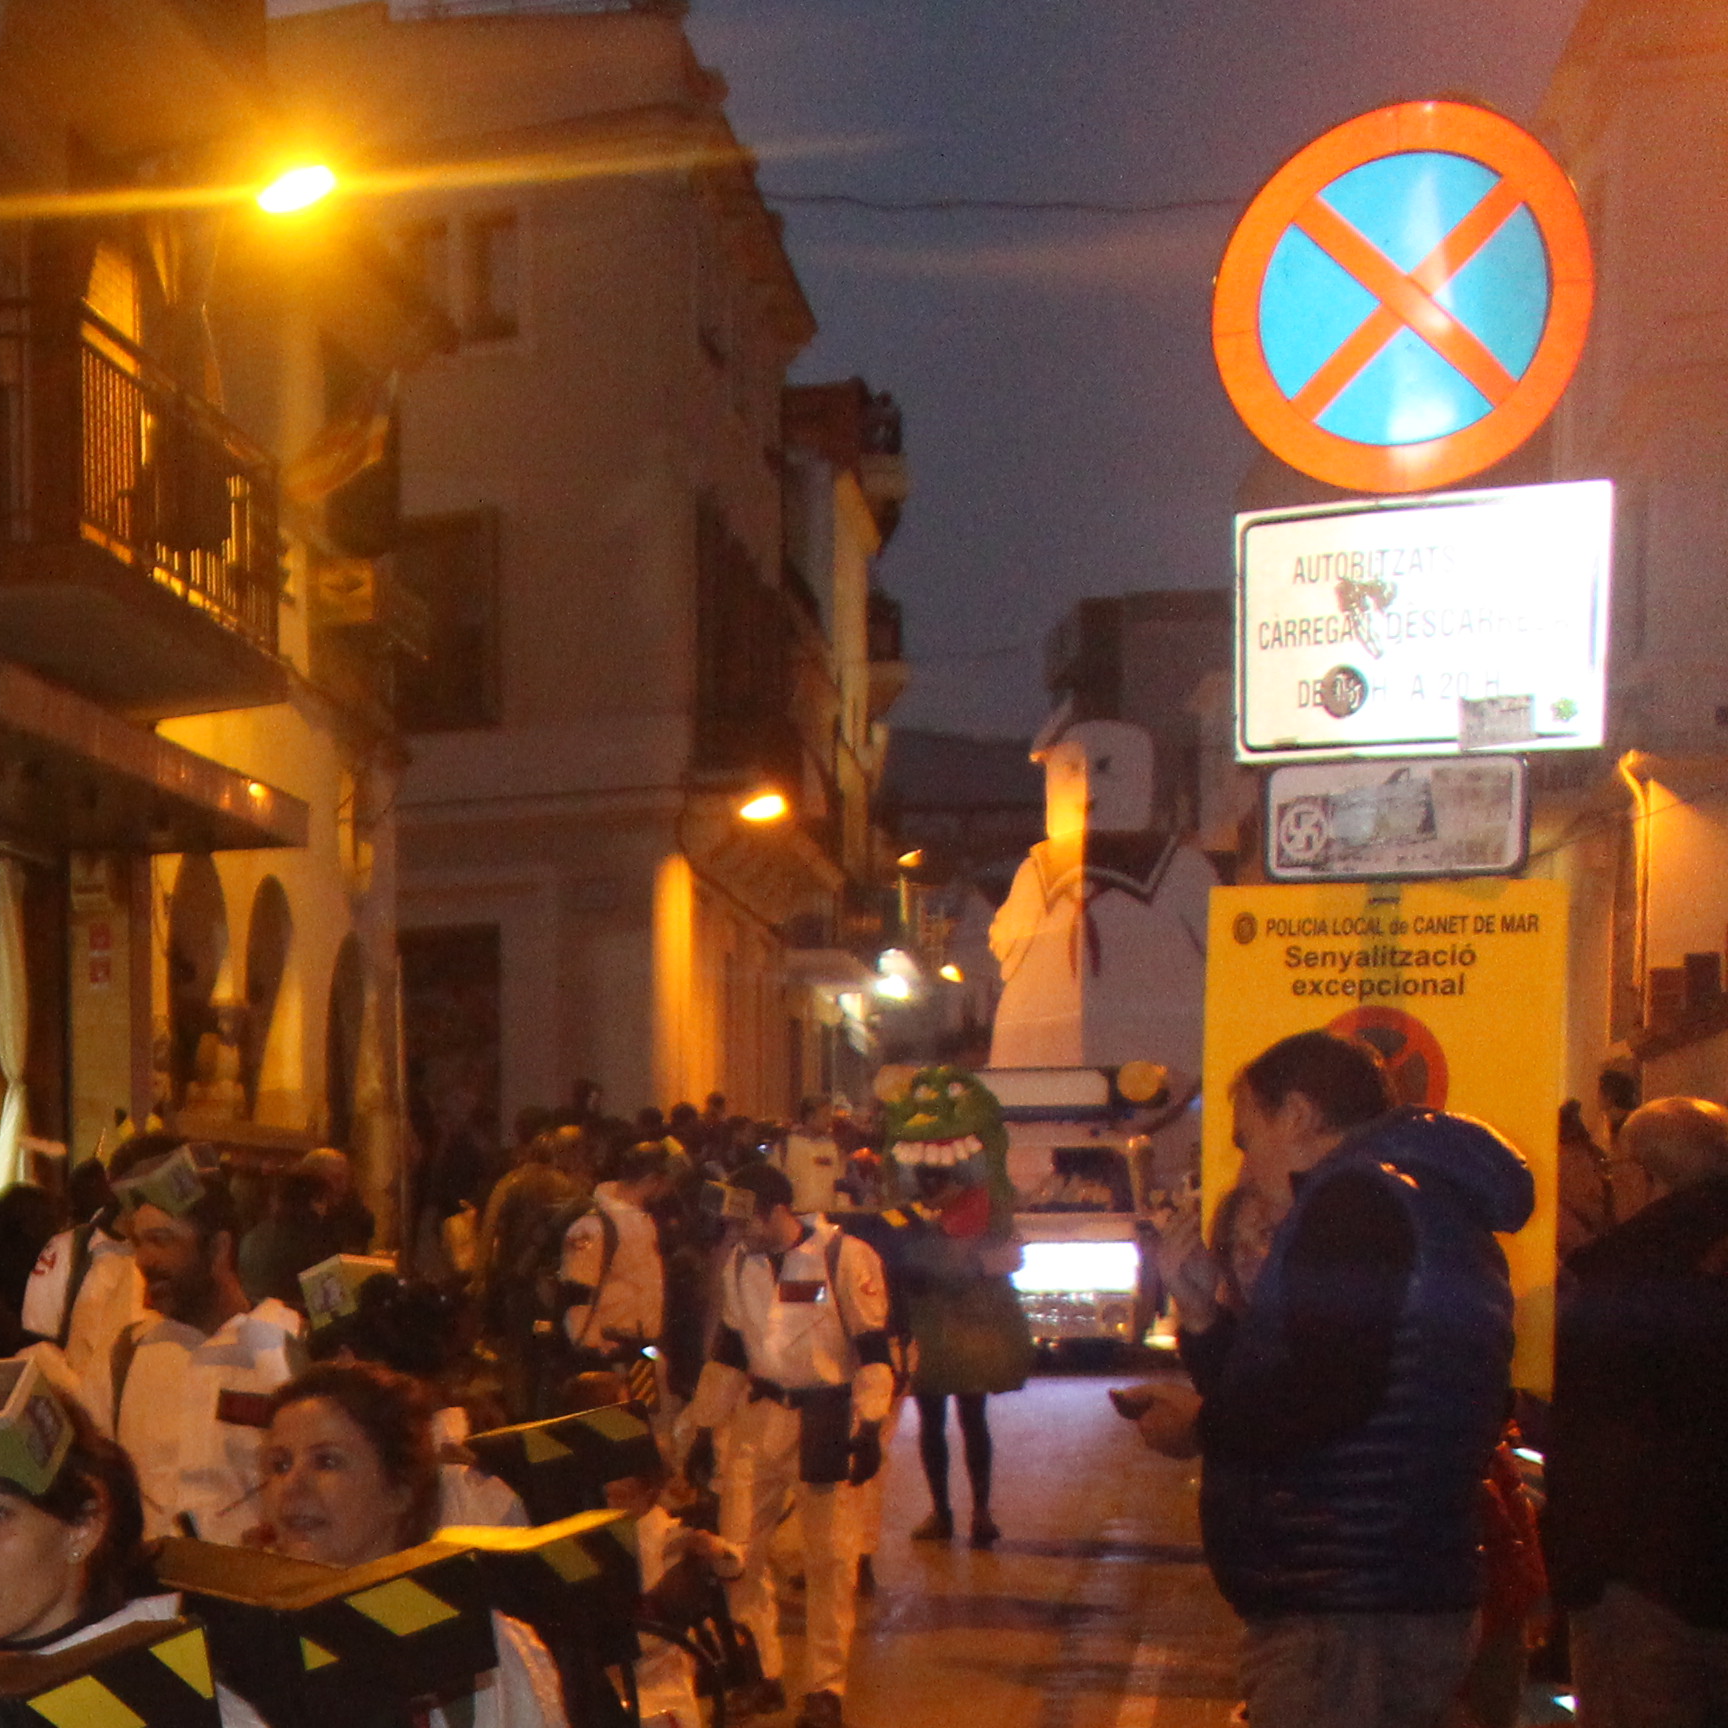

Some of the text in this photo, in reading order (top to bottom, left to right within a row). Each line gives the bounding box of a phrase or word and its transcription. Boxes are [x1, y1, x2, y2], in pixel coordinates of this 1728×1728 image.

[1332, 916, 1384, 936] LOCAL
[1389, 918, 1409, 936] de
[1413, 915, 1467, 935] CANET
[1473, 914, 1496, 933] DE
[1500, 913, 1540, 933] MAR
[1284, 942, 1477, 973] Senyalització
[1291, 973, 1465, 1002] excepcional
